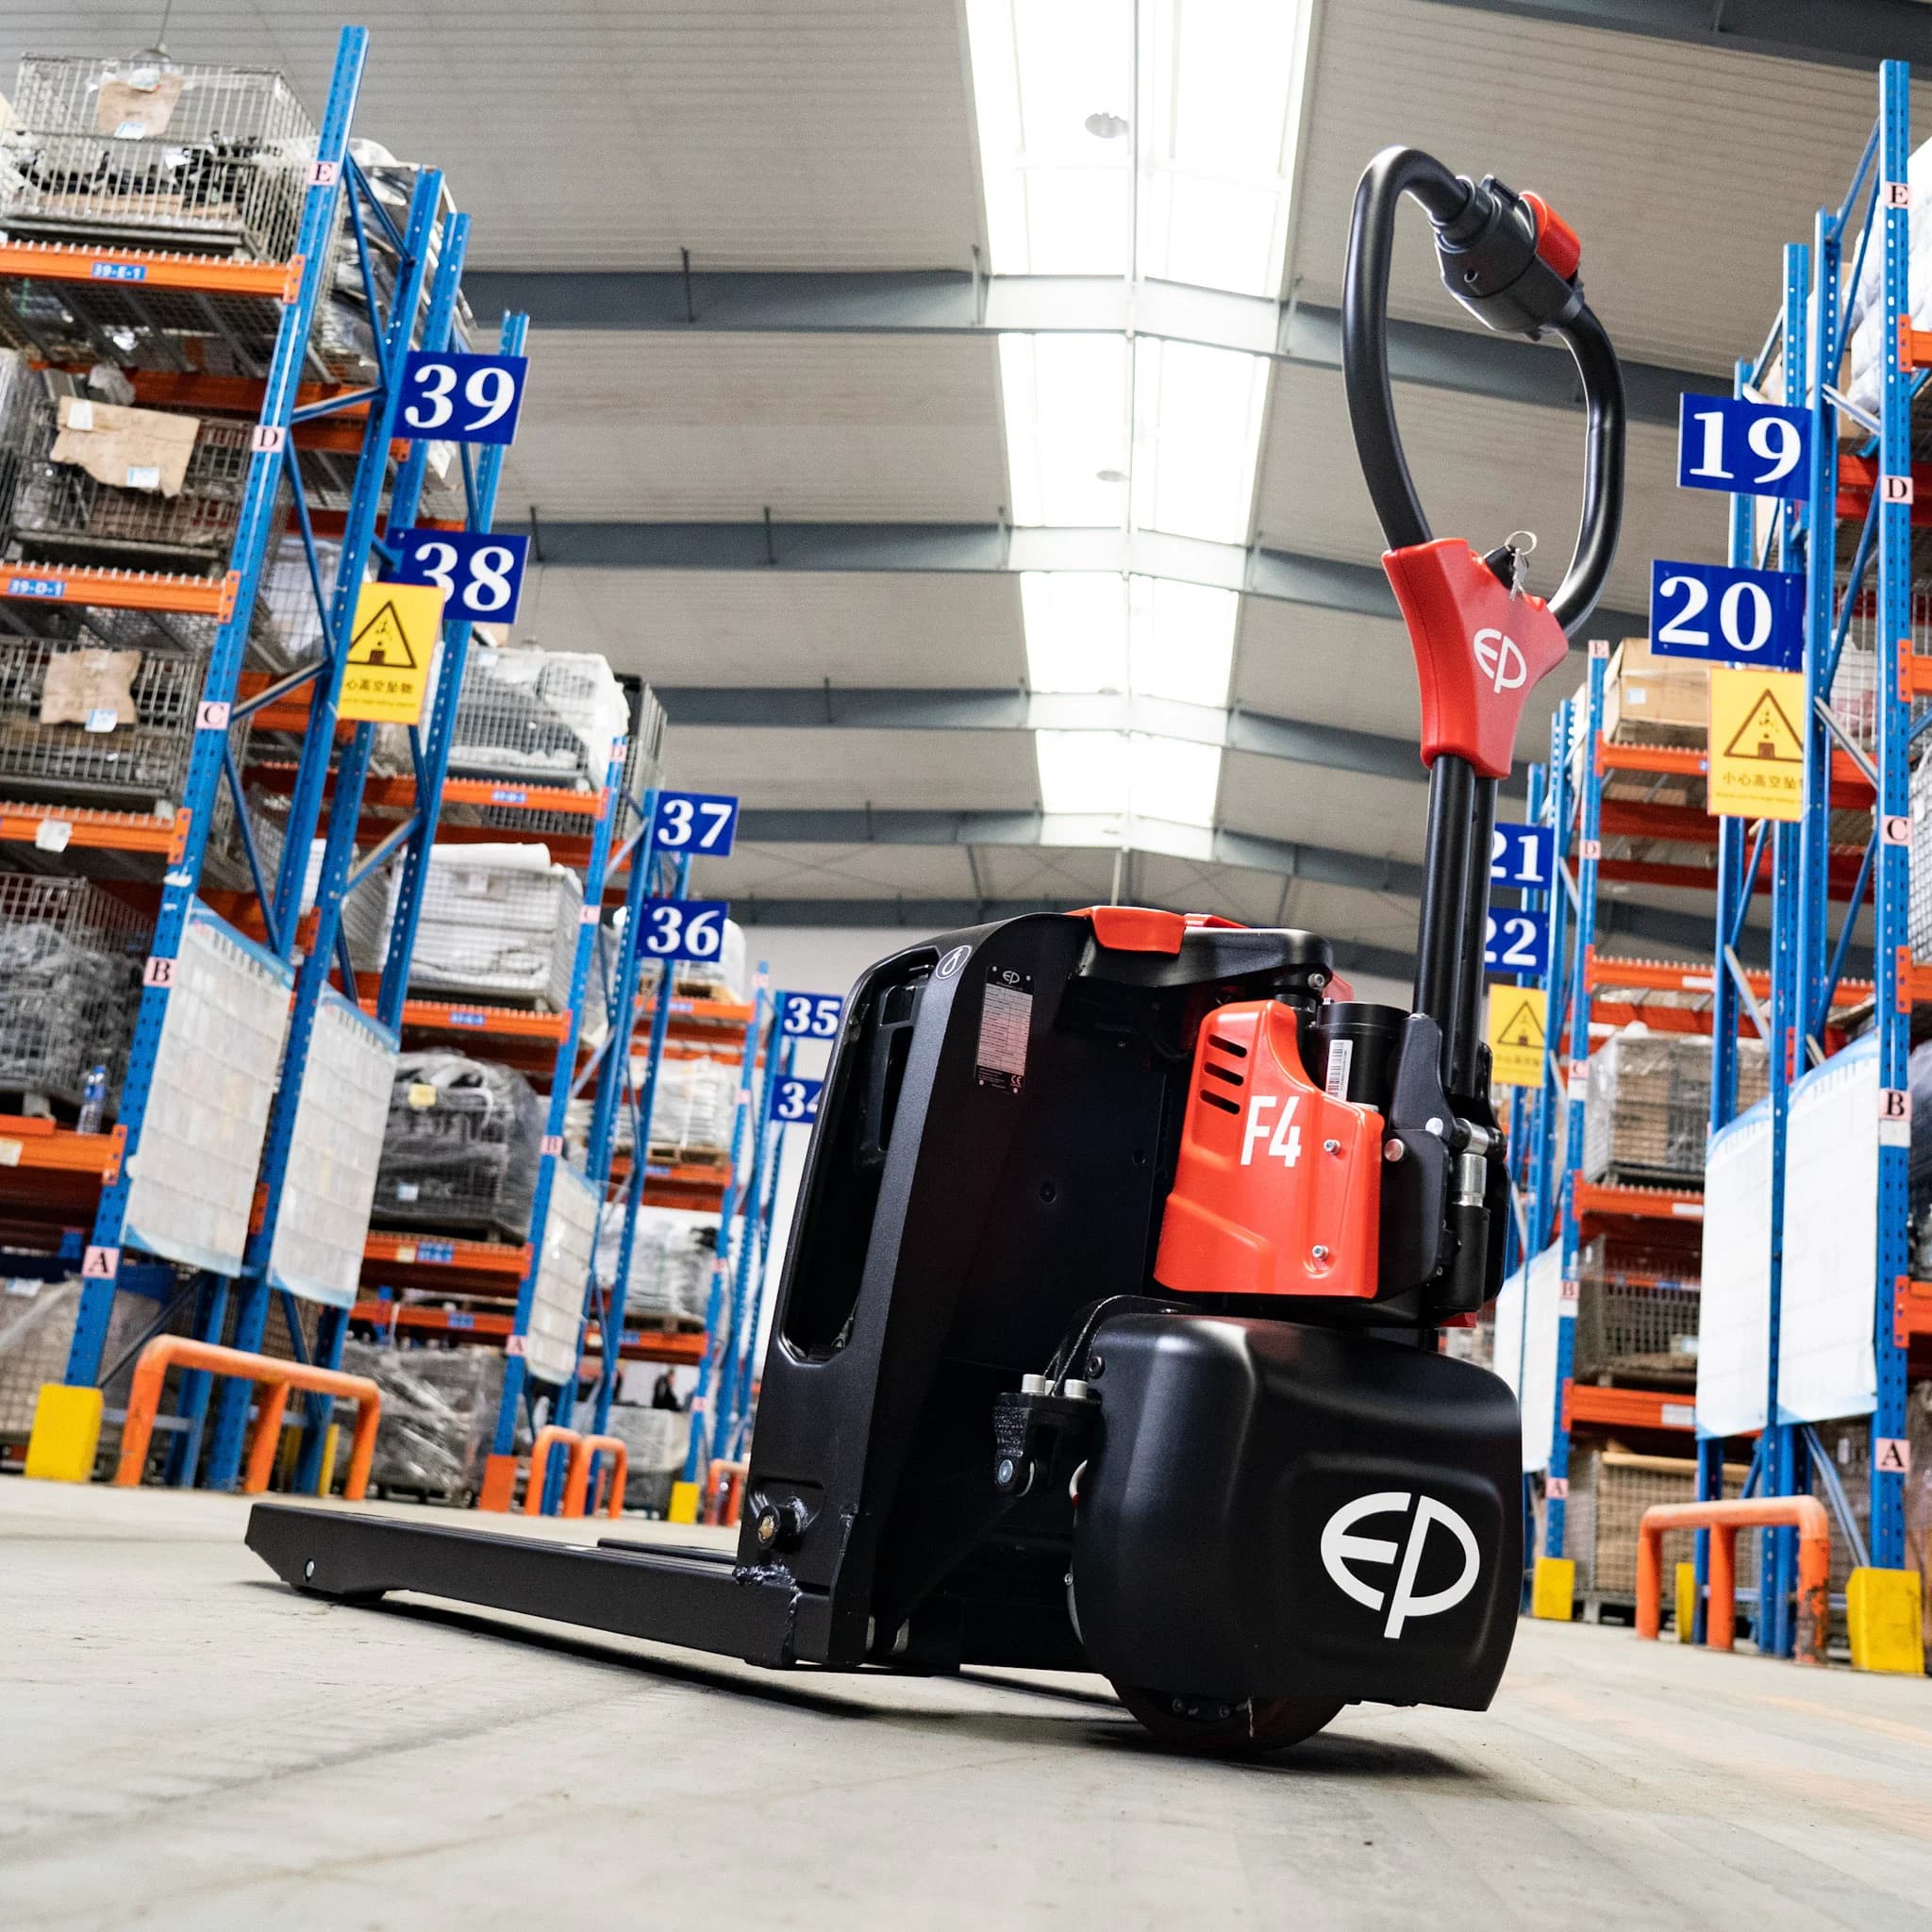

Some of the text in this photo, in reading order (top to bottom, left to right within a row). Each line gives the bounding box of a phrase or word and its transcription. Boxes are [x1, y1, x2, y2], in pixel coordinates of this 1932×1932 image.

[315, 163, 333, 182] E
[1890, 184, 1908, 205] E
[404, 363, 516, 431] 39
[258, 427, 279, 448] D
[1689, 411, 1802, 483] 19
[1886, 477, 1908, 499] D
[414, 541, 515, 612] 38
[1657, 575, 1773, 651] 20
[1473, 627, 1527, 694] EP
[204, 703, 225, 726] C
[658, 798, 733, 848] 37
[1886, 817, 1909, 841] C
[646, 906, 721, 957] 36
[151, 960, 172, 983] B
[783, 996, 841, 1037] 35
[1885, 1091, 1906, 1117] B
[1240, 1094, 1302, 1168] F4
[87, 1250, 110, 1274] A
[1880, 1440, 1906, 1469] A
[1321, 1491, 1480, 1640] EP
